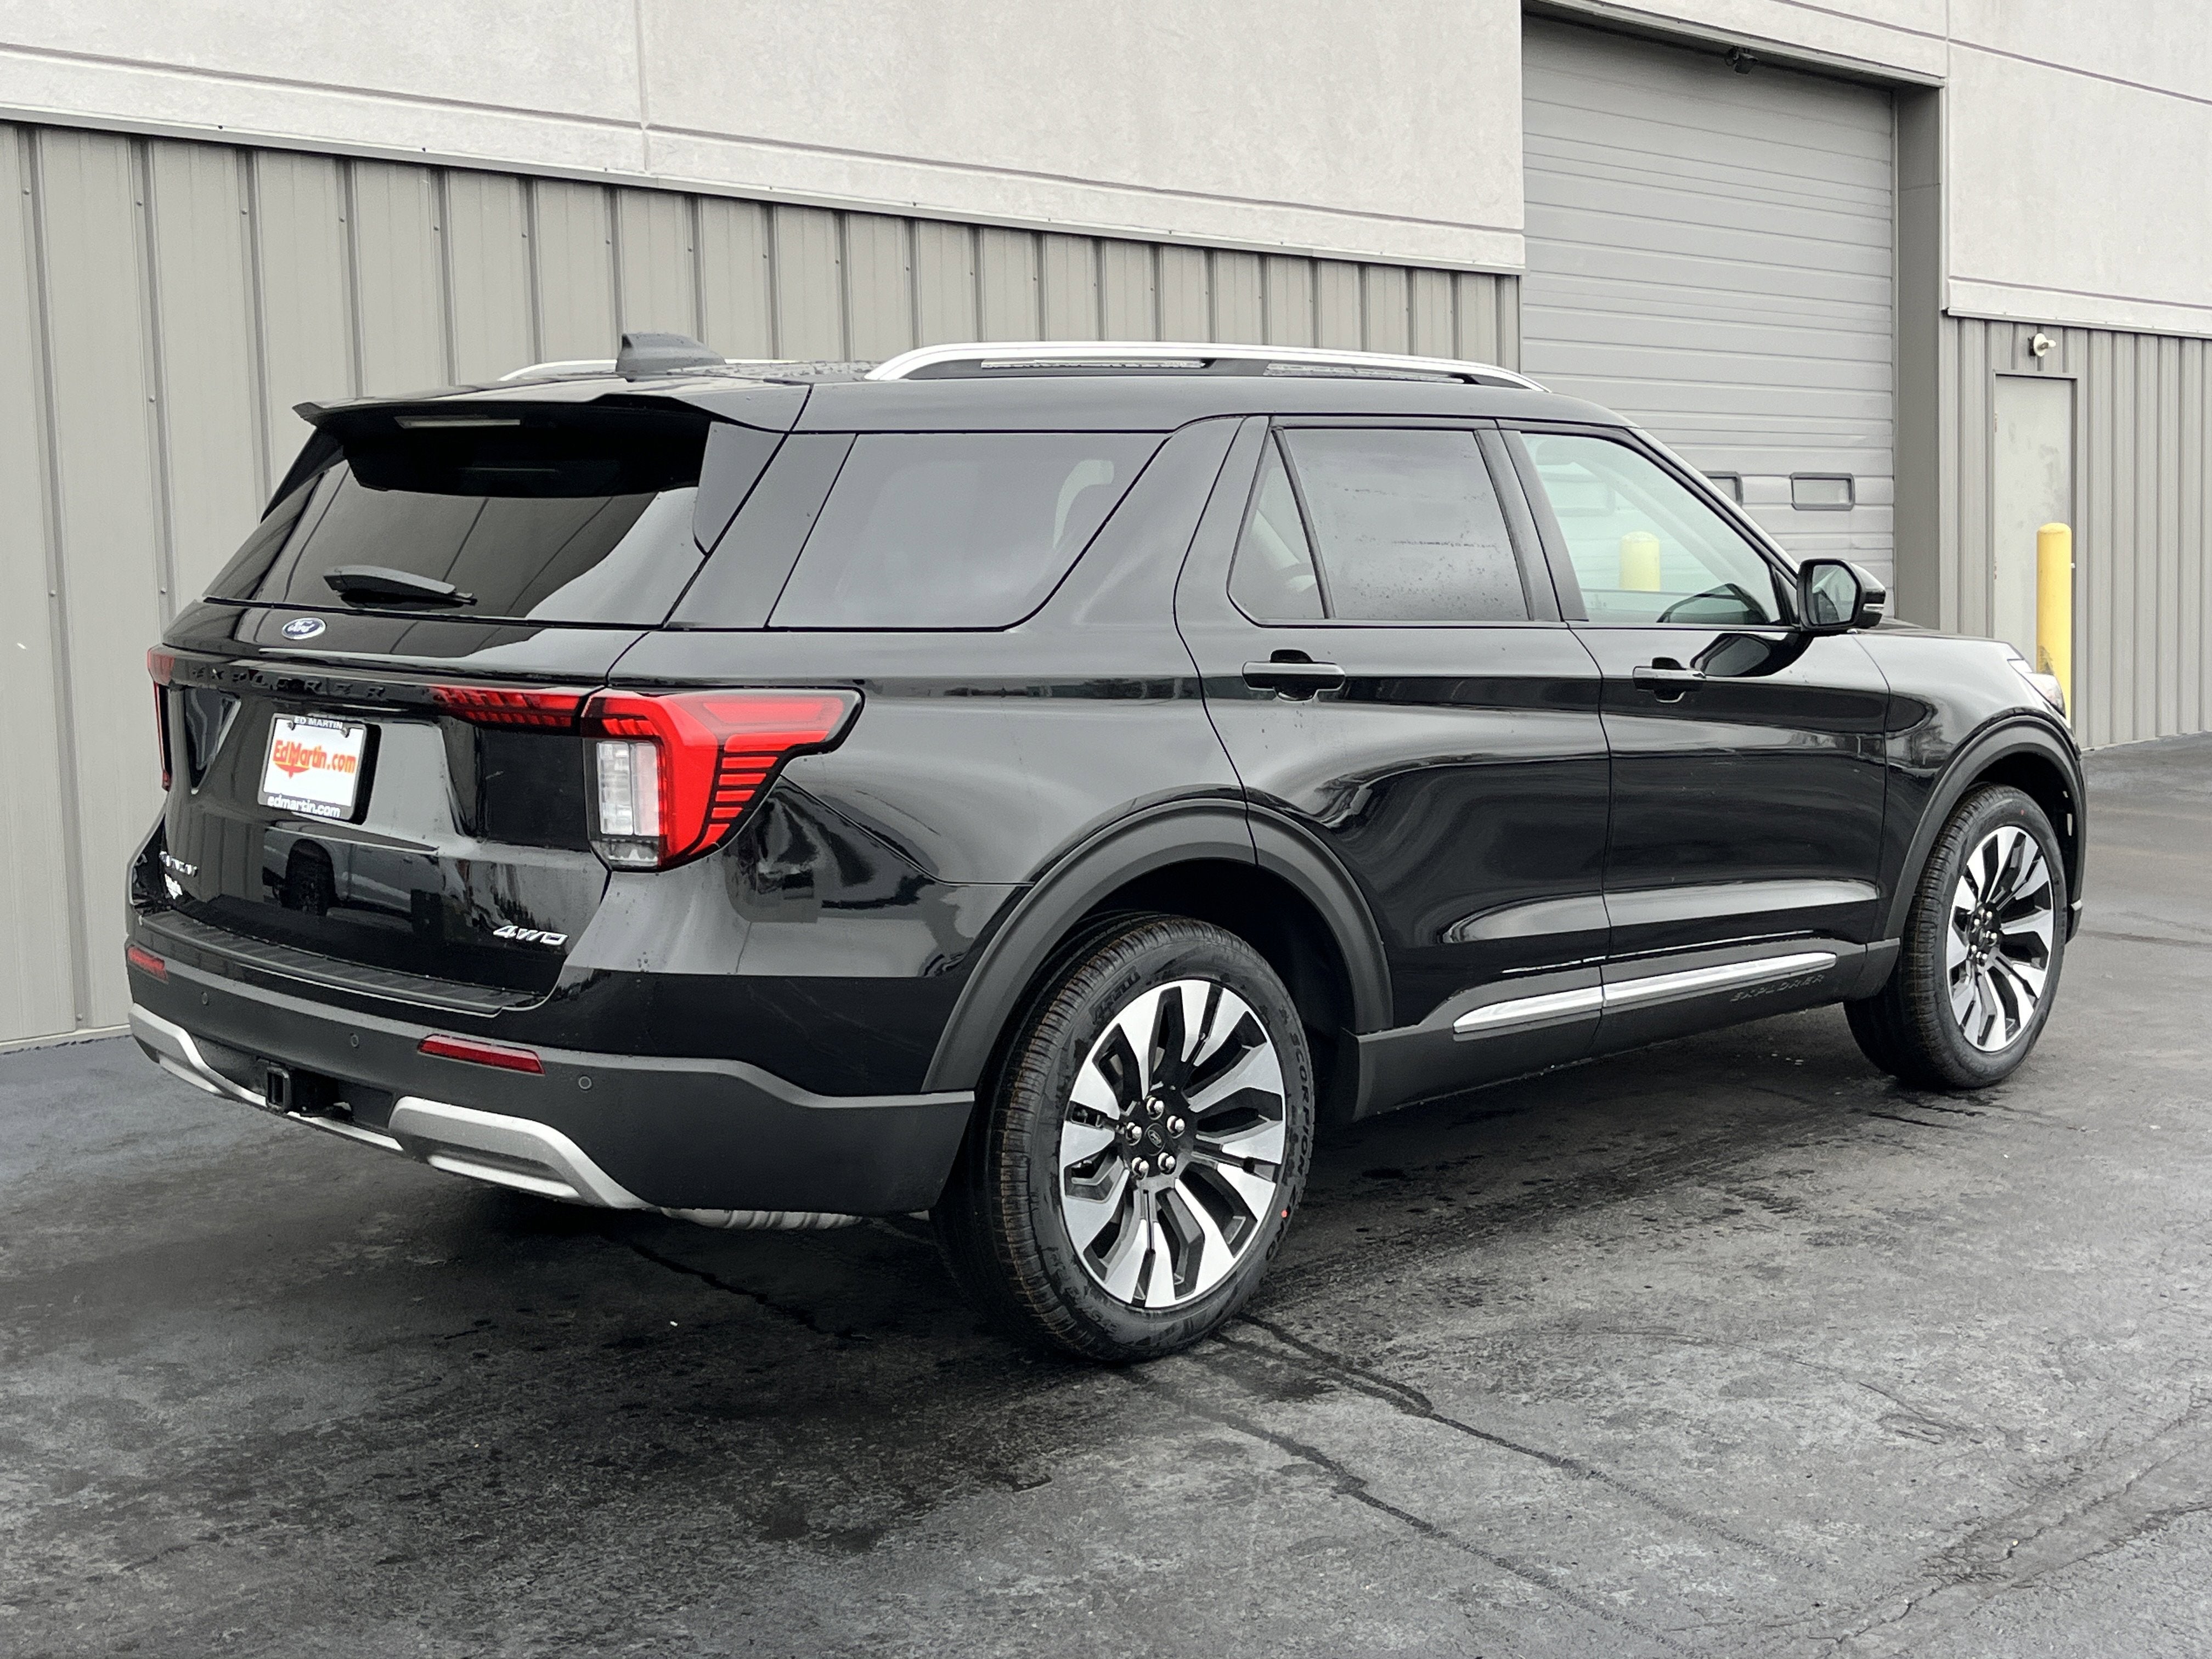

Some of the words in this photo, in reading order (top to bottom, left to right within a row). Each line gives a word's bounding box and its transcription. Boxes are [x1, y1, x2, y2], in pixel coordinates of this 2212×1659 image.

[294, 716, 307, 725] ED
[309, 718, 343, 729] MARTIN
[273, 740, 357, 774] EdMartin.com
[267, 794, 341, 817] edmartin.com
[493, 925, 568, 946] 4WD
